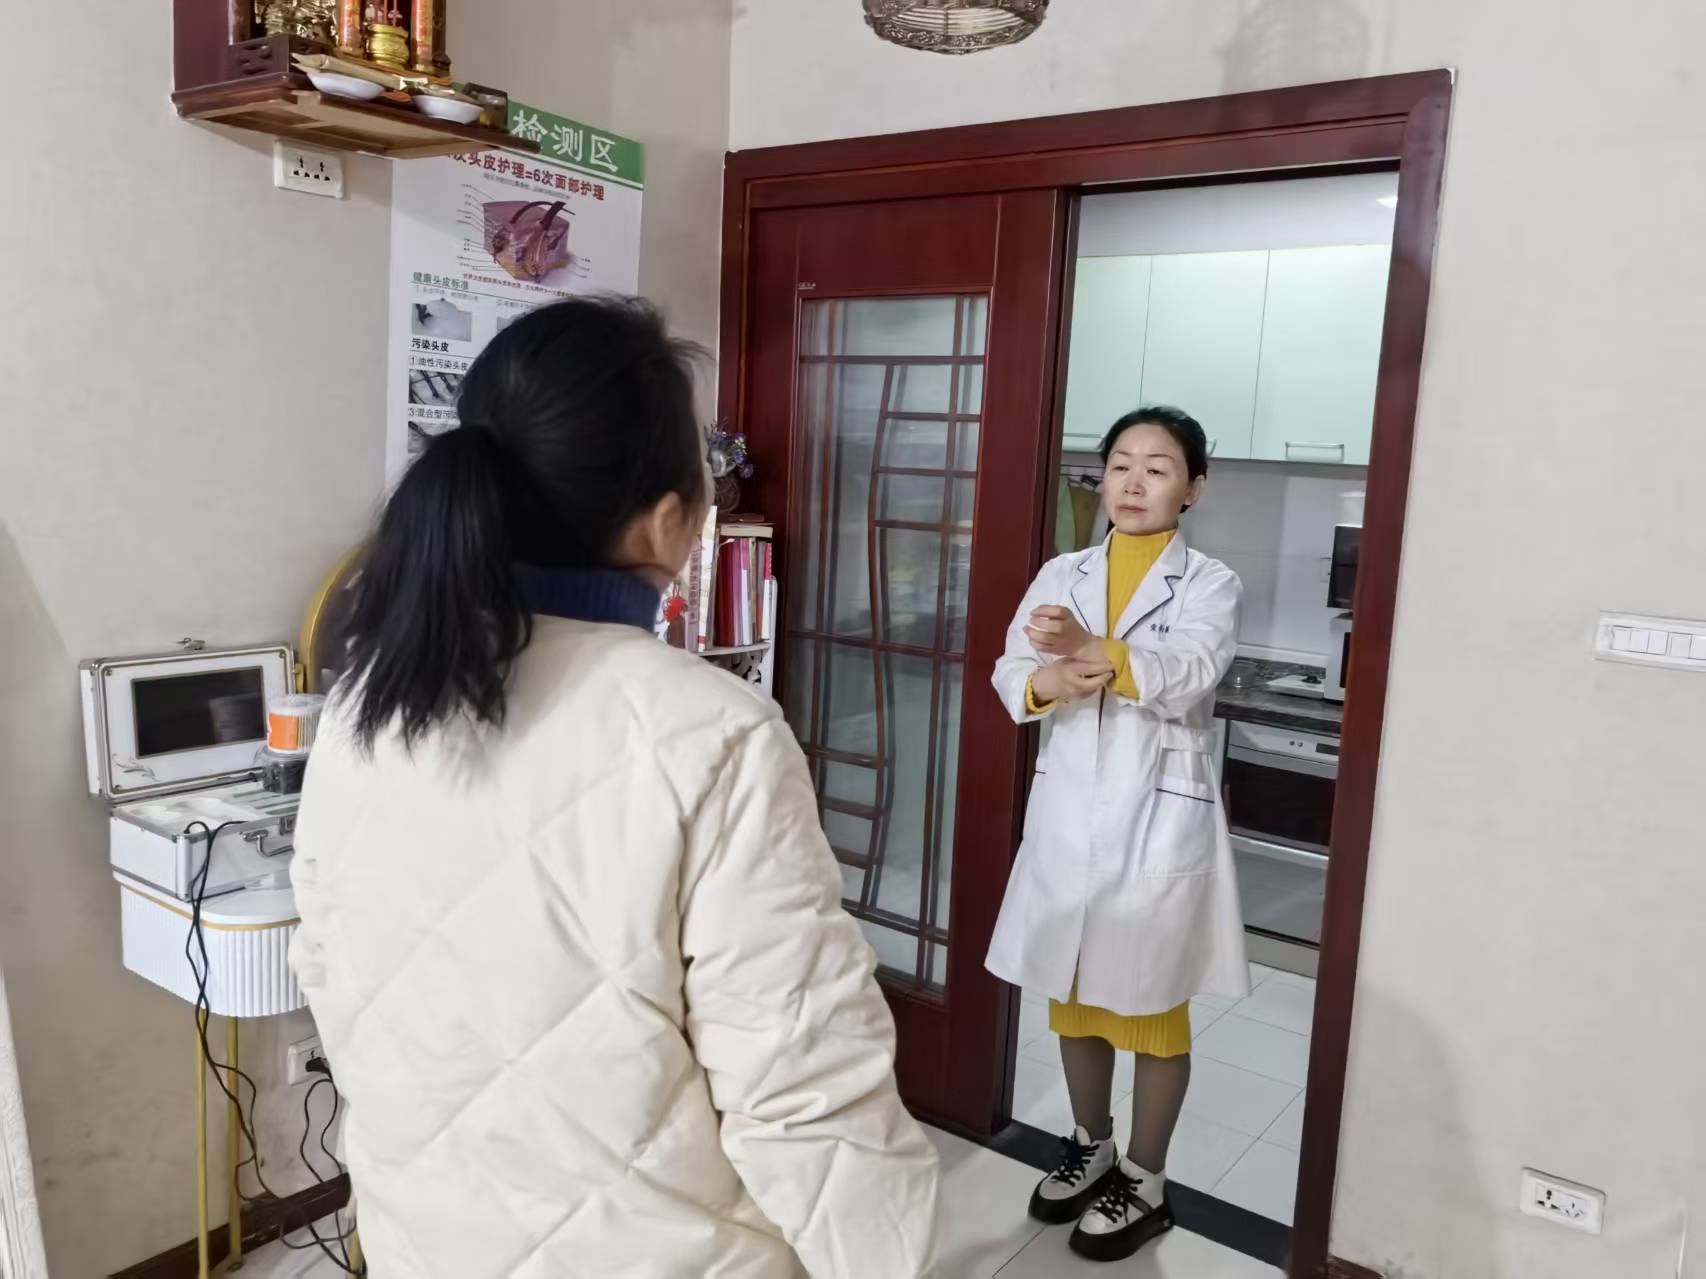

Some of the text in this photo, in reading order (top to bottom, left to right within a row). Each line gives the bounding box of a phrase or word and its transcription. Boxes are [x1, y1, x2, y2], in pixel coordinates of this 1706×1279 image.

[511, 109, 618, 172] 检测区
[448, 151, 605, 200] 次头皮护理=6次面部护理
[411, 338, 449, 352] 污染头皮
